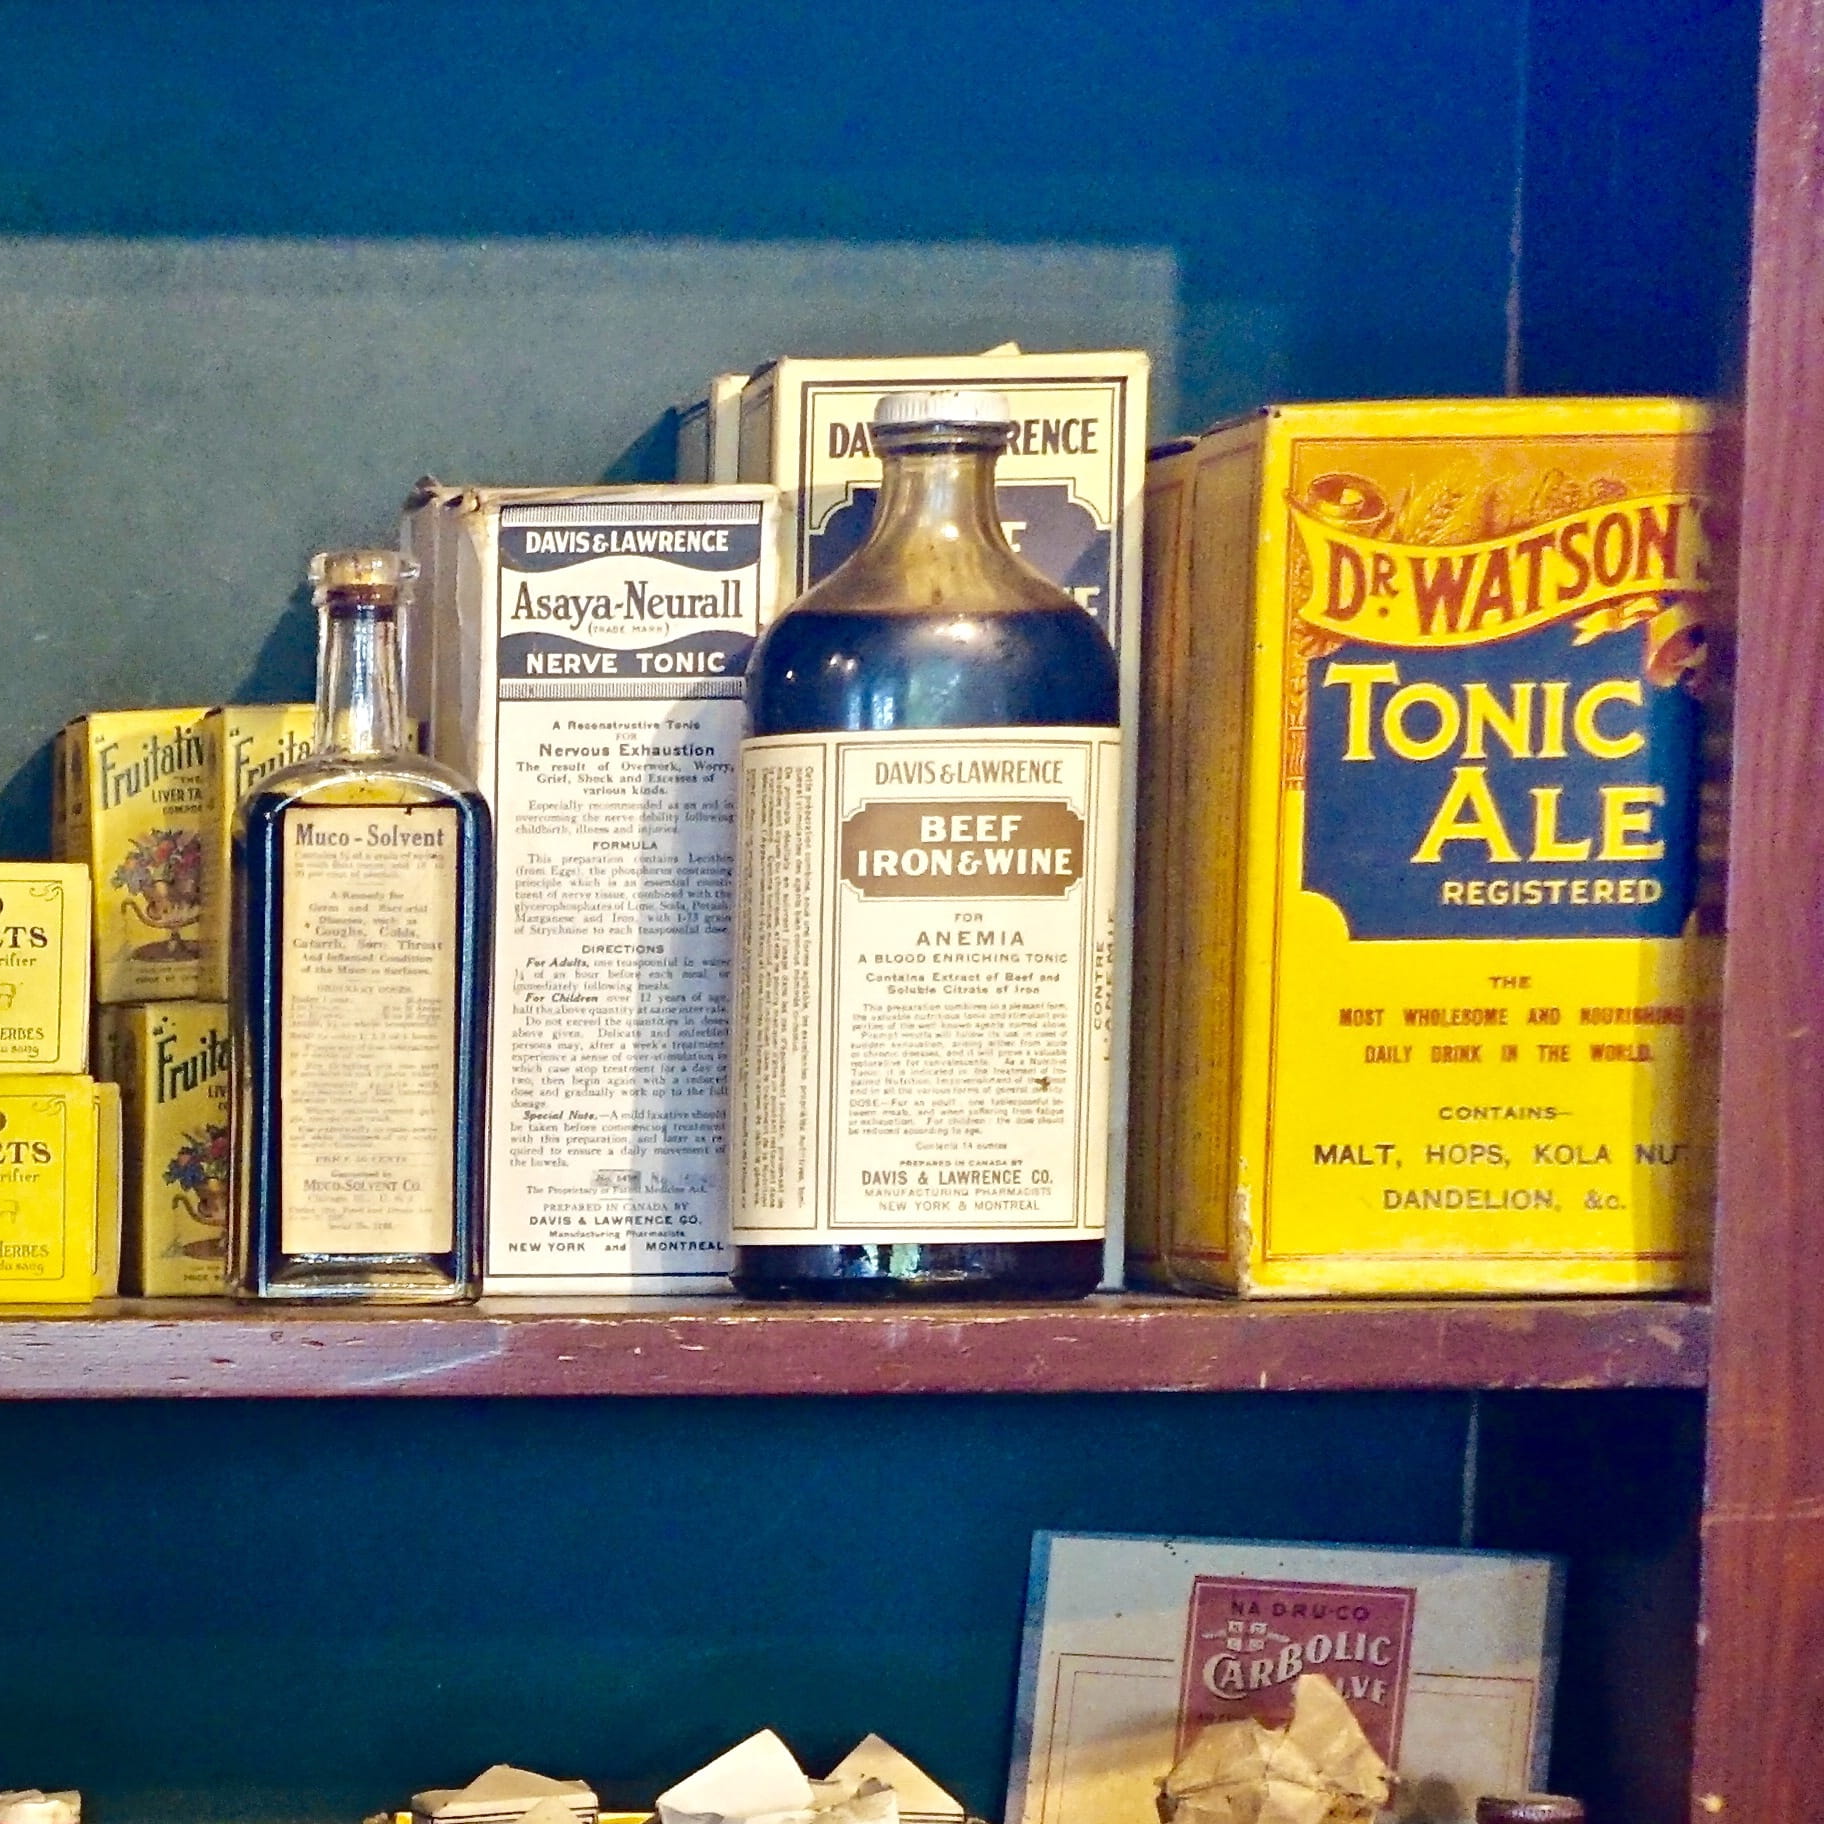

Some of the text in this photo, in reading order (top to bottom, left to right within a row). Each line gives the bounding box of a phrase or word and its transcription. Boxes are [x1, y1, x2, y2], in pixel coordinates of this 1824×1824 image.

[510, 579, 744, 630] Asaya-Neurall
[524, 651, 727, 675] NERVE TONIC
[1322, 661, 1647, 762] TONIC
[538, 743, 715, 758] Nervous Exhaustion
[1410, 767, 1667, 864] ALE
[919, 815, 1023, 844] BEEF
[1442, 879, 1663, 906] REGISTERED
[874, 953, 1069, 964] BLOOD ENRICHING TONIC
[1312, 1142, 1612, 1169] MALT, HOPS, KOLA
[862, 1169, 1054, 1186] DAVIS LAWRENCE CO.
